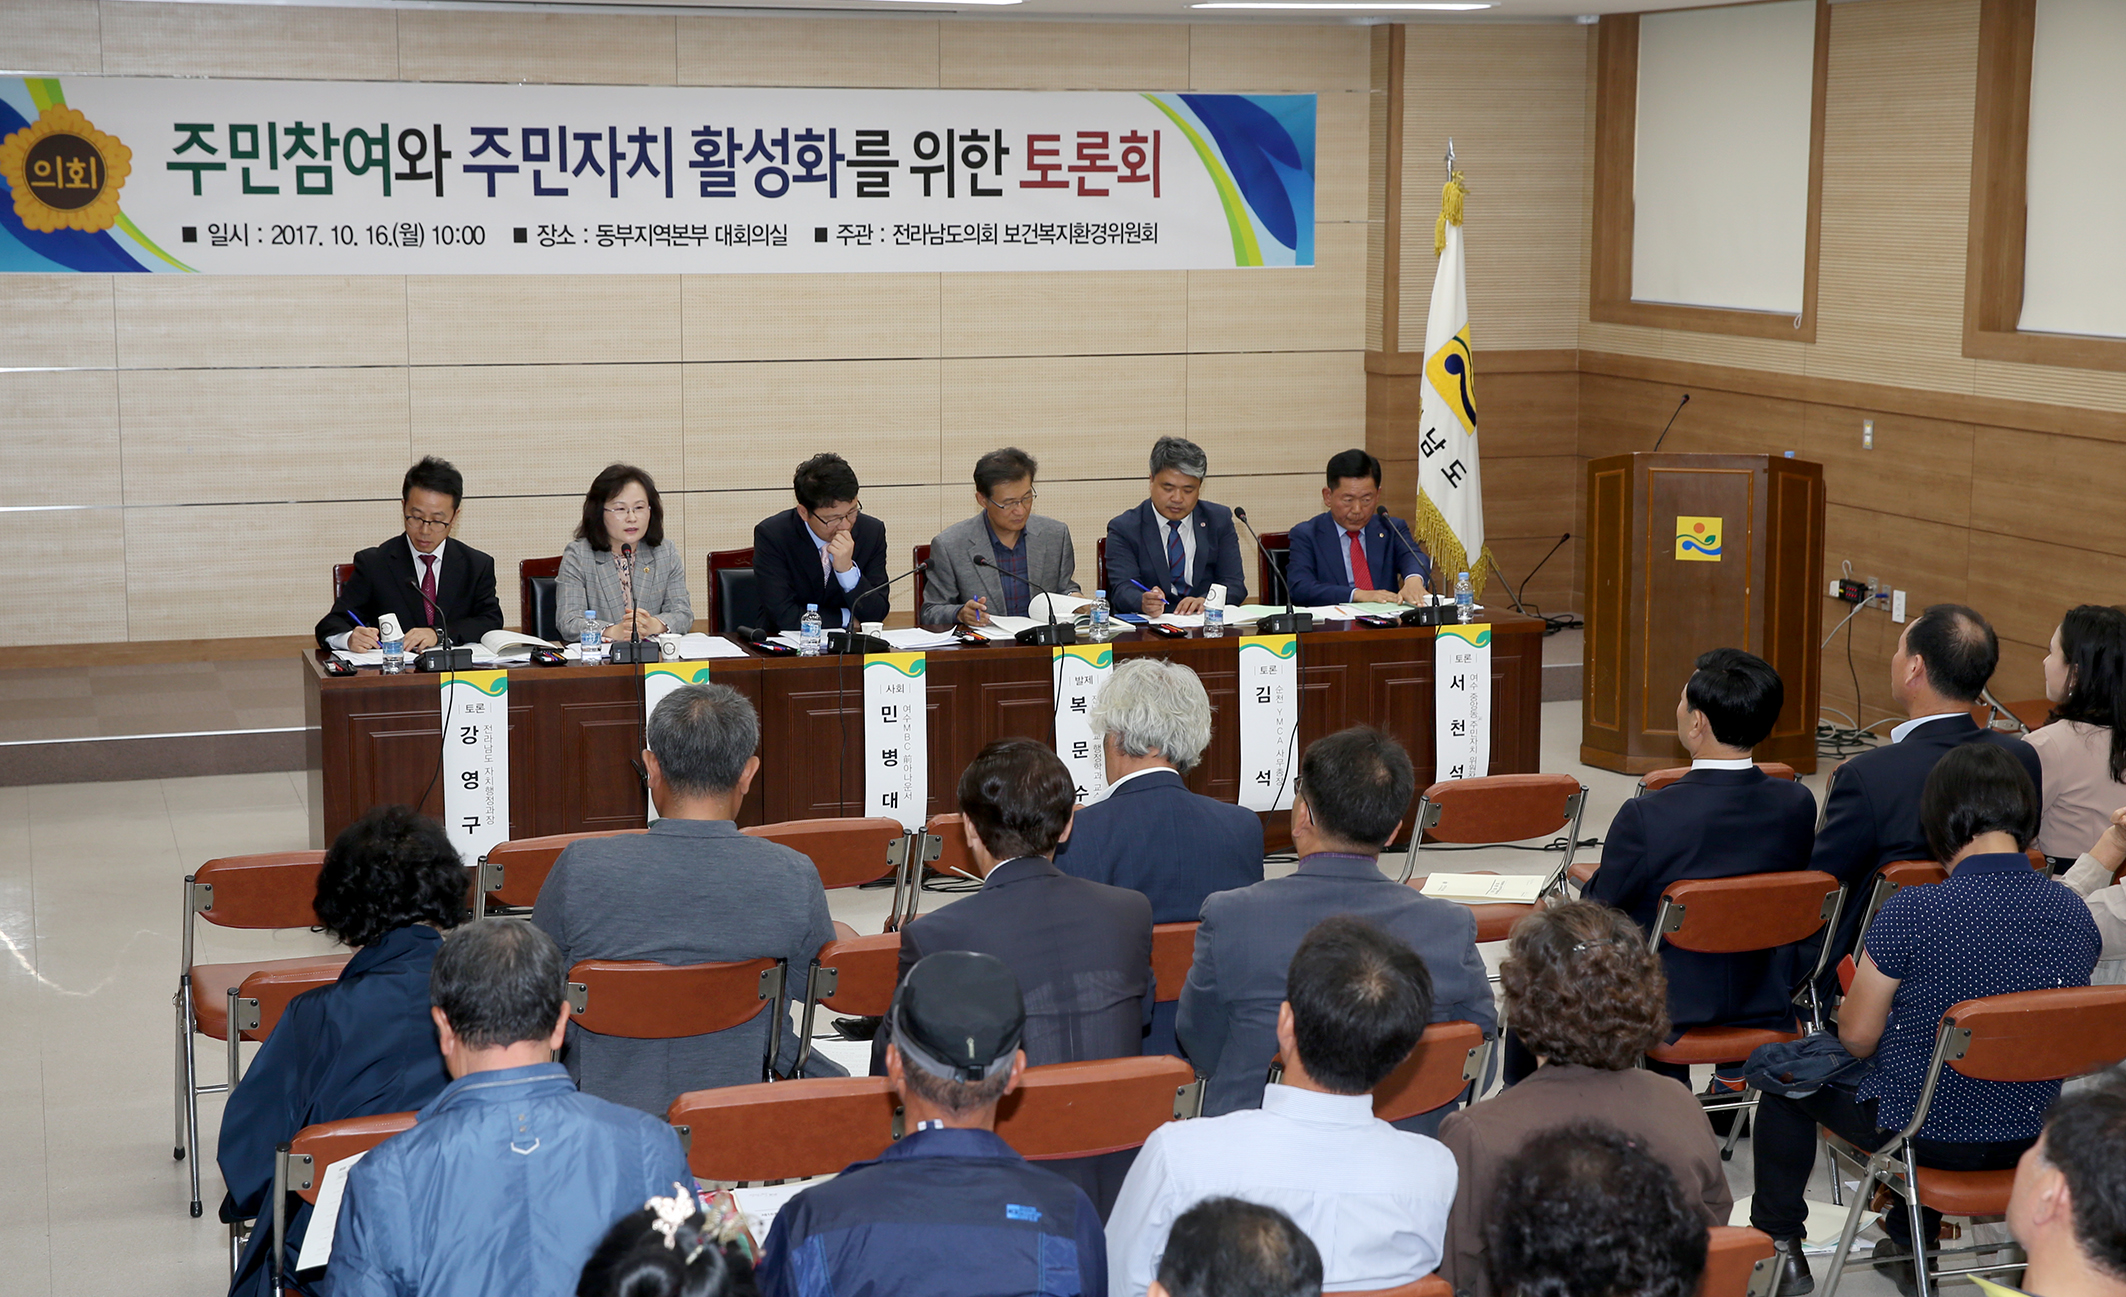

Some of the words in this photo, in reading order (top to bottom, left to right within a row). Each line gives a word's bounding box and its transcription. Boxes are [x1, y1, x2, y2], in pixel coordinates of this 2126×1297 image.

[31, 155, 98, 190] 의회
[167, 121, 451, 197] 주민참여와
[463, 125, 673, 198] 주민자치
[689, 125, 899, 199] 활성화를
[910, 128, 1010, 199] 위한
[1019, 129, 1161, 199] 토론회
[208, 223, 249, 247] 일시
[271, 225, 323, 247] 2017.
[331, 225, 359, 247] 10.
[366, 222, 425, 248] 16.(월)
[432, 225, 486, 246] 10:00
[538, 223, 577, 248] 장소
[595, 223, 709, 248] 동부지역본부
[715, 223, 788, 247] 대회의실
[837, 223, 874, 247] 주관
[892, 223, 998, 246] 전라남도의회
[1003, 222, 1158, 245] 보건복지환경위원회
[1420, 427, 1467, 489] 남도
[1259, 665, 1277, 675] 토론
[1454, 653, 1472, 664] 토론
[885, 683, 905, 694] 사회
[1074, 675, 1094, 686] 발제
[1469, 673, 1478, 690] 여수
[1275, 685, 1284, 704] 순천
[464, 703, 486, 714] 토론
[902, 704, 912, 751] 여수MBC
[1276, 708, 1284, 745] YMCA
[1469, 720, 1478, 754] 주민자치
[483, 724, 494, 763] 전라남도
[1275, 749, 1285, 786] 사무총장
[484, 766, 495, 826] 자치행정과장
